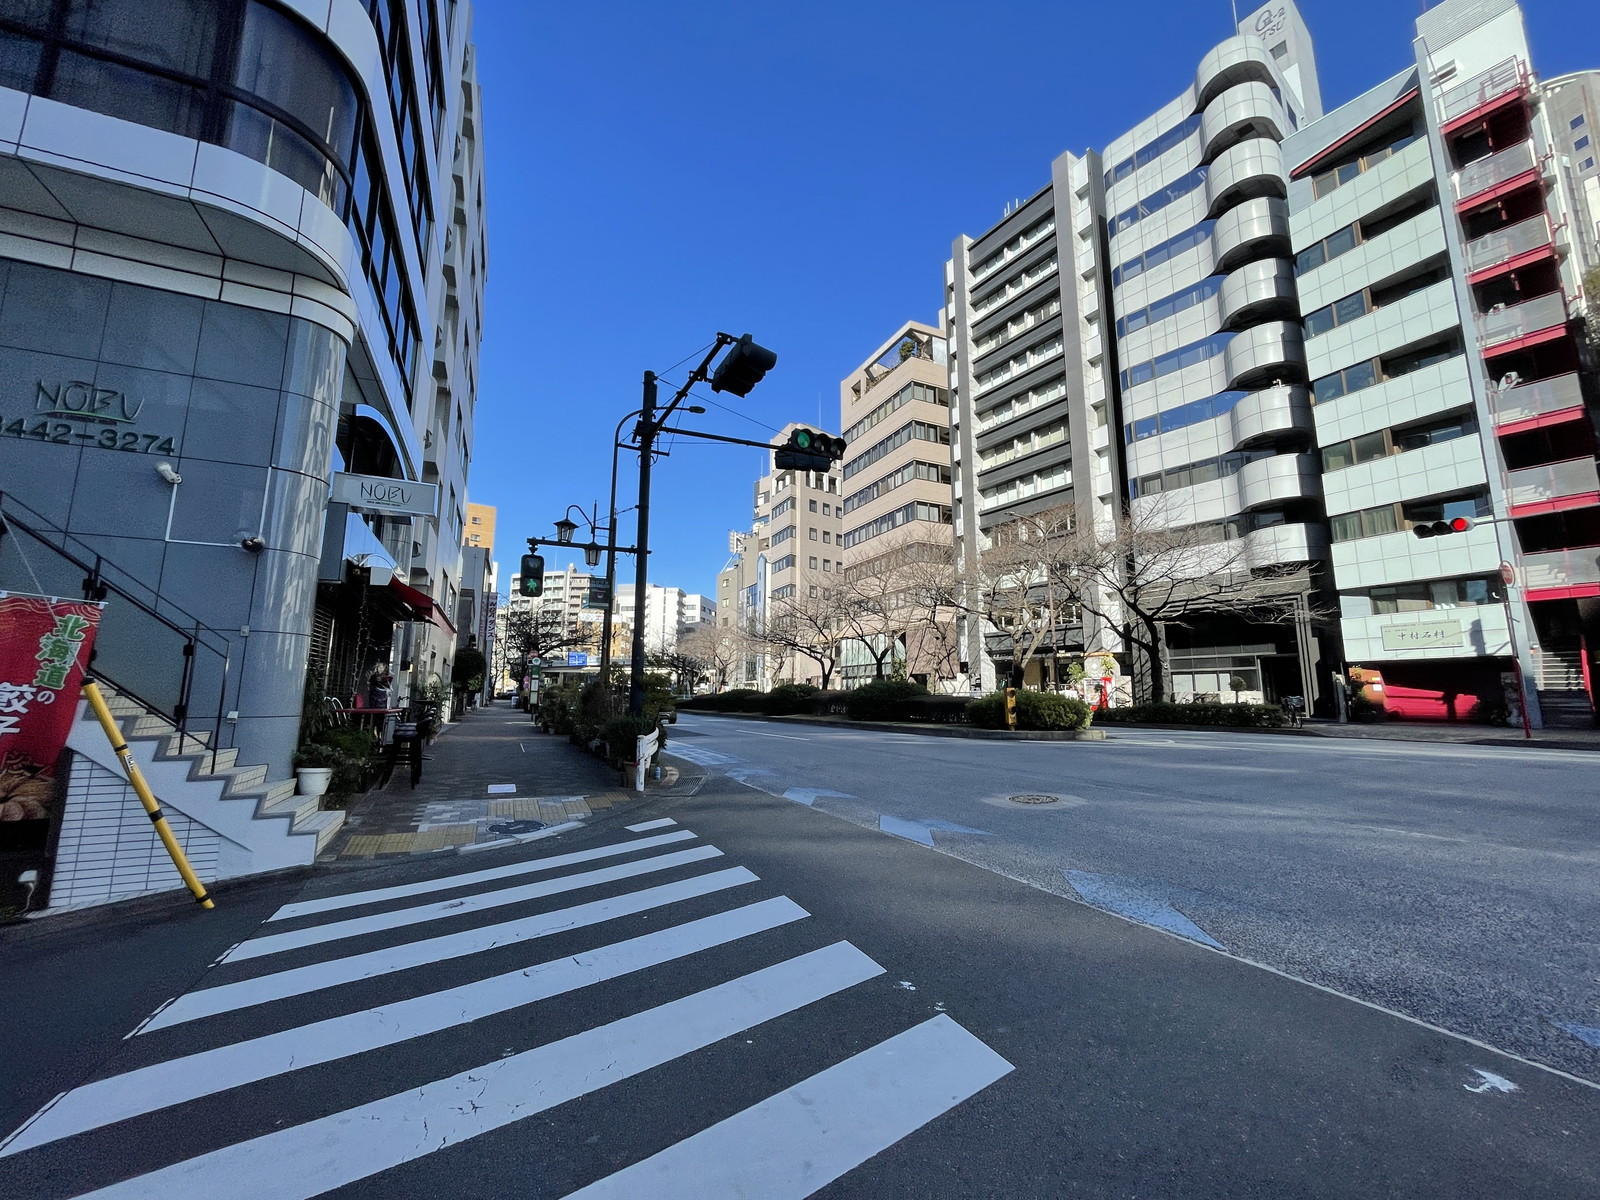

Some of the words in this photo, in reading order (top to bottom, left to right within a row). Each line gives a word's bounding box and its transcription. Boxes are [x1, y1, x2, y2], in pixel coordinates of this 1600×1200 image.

[35, 379, 145, 420] NOBU
[0, 416, 175, 456] 442-3274
[360, 481, 413, 504] NOBU
